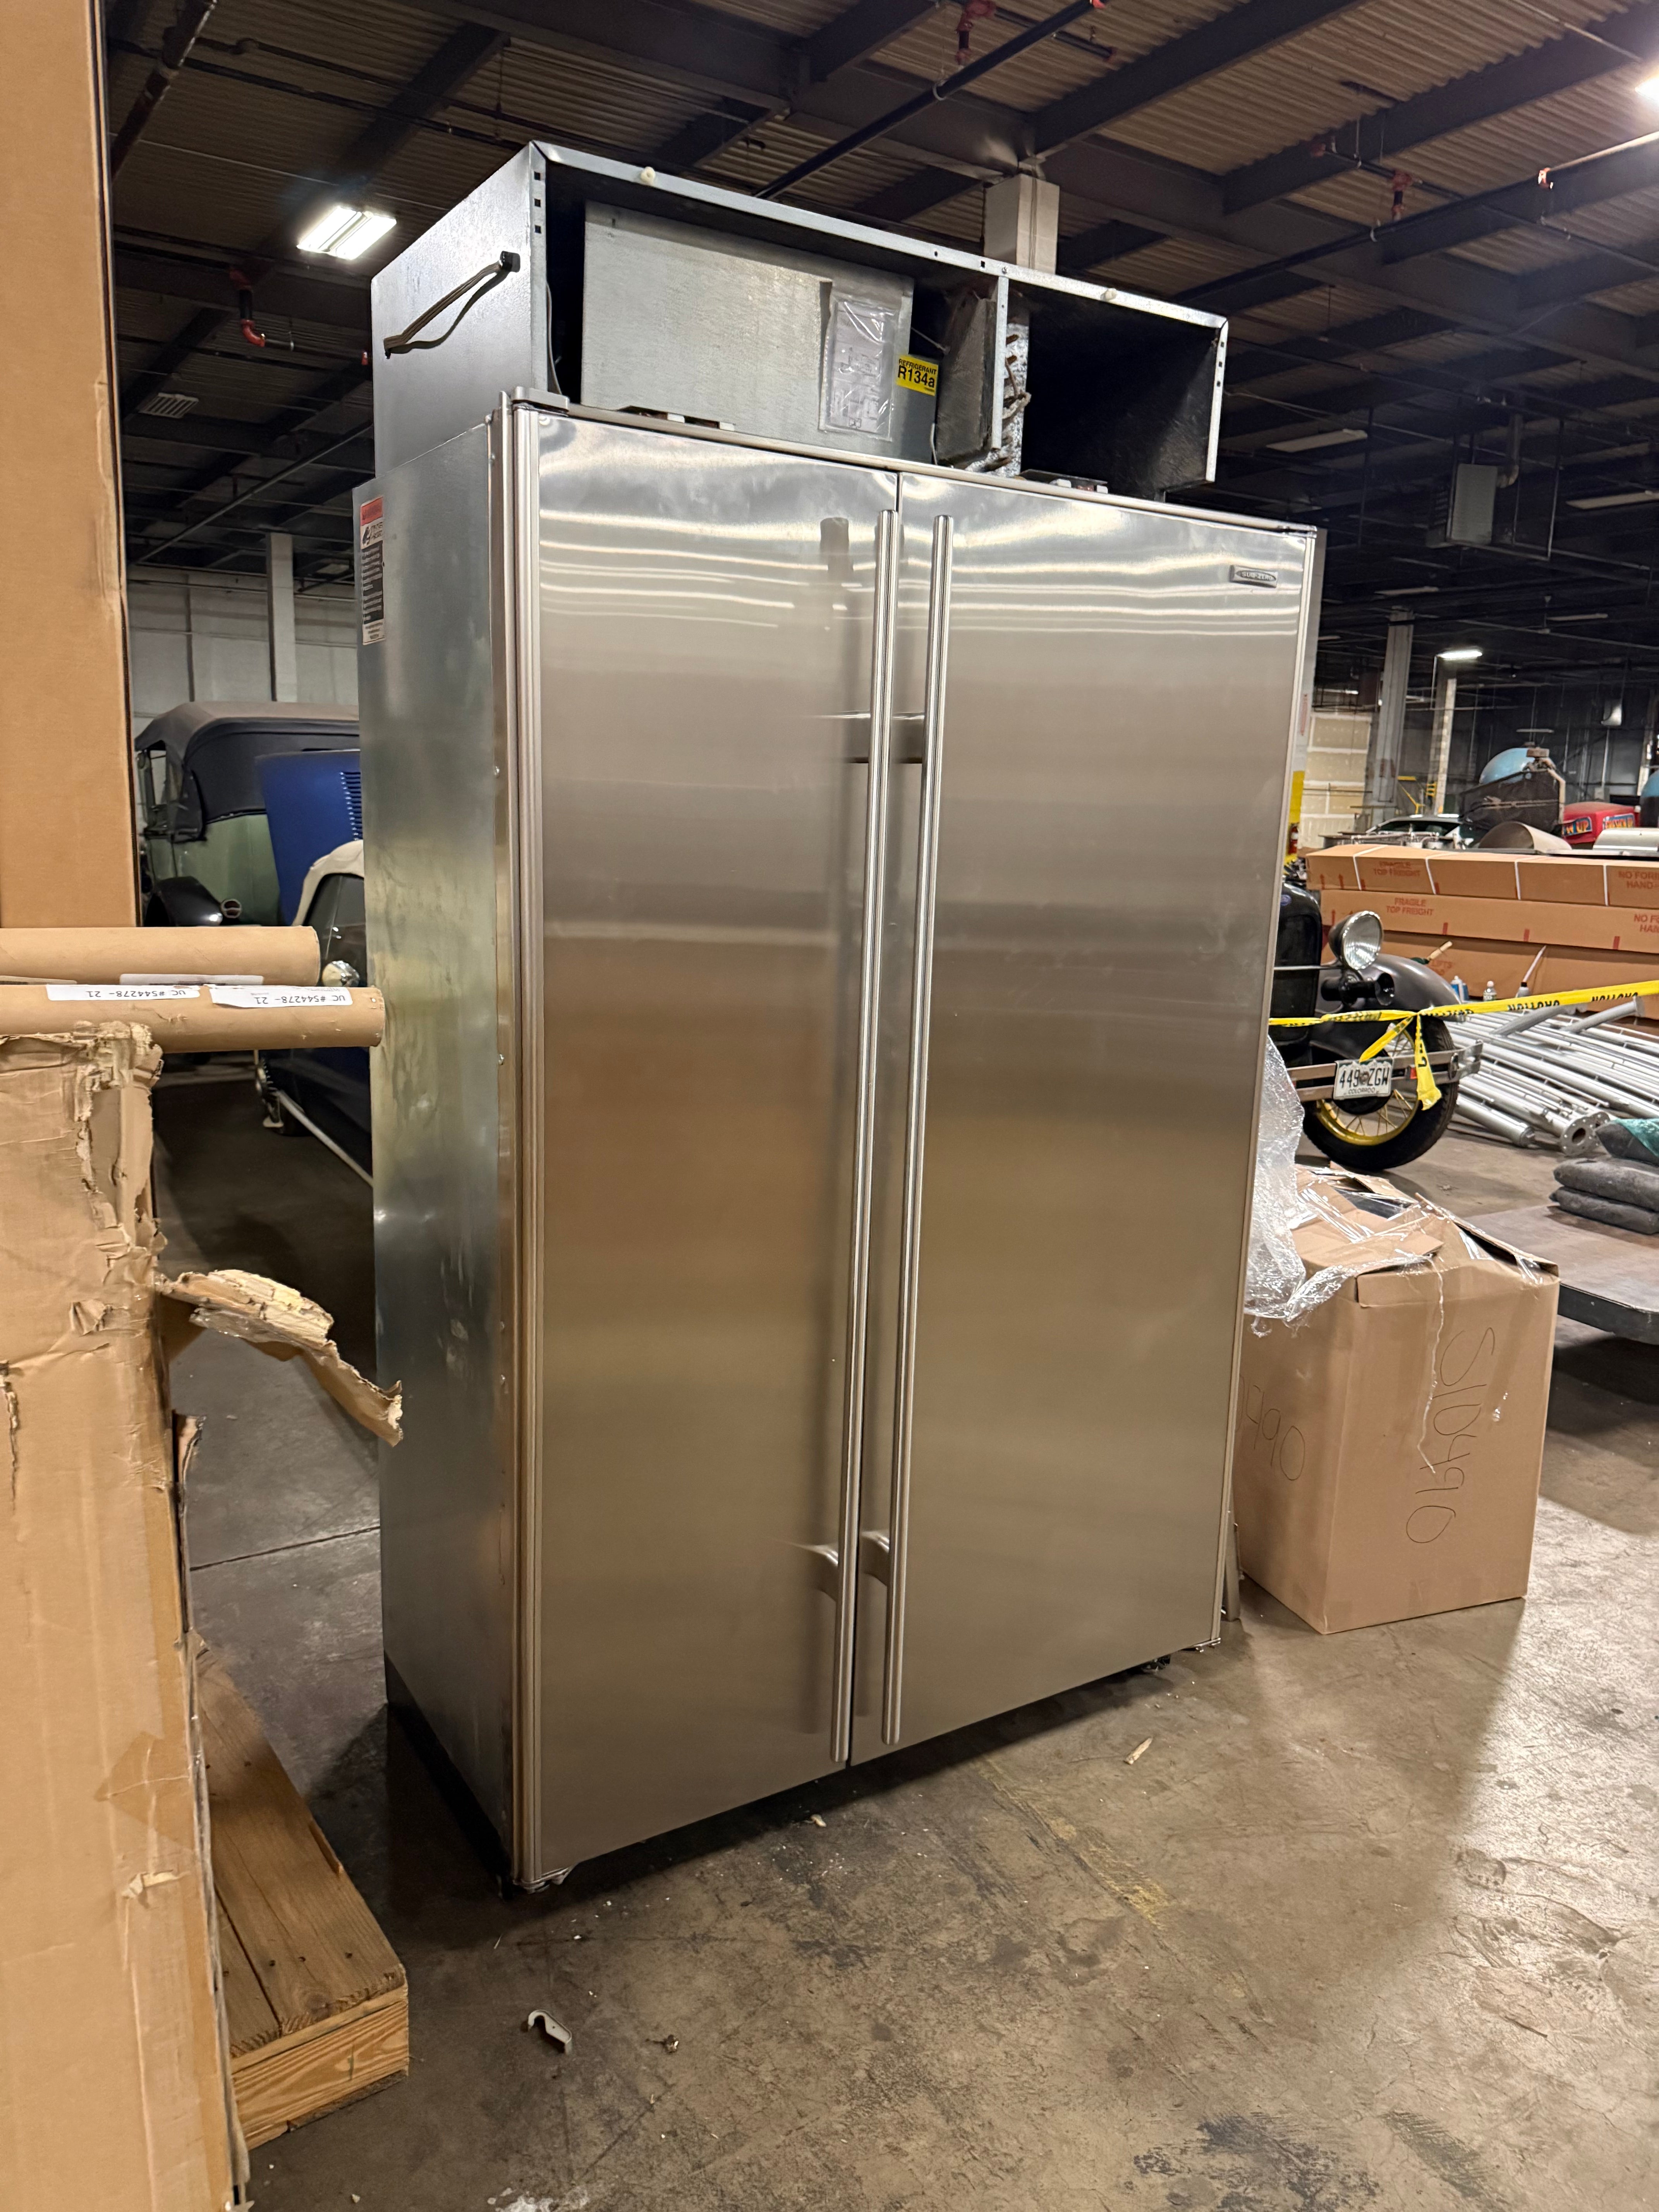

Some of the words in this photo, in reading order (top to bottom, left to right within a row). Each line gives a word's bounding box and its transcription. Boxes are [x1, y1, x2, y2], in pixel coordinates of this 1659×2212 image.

[898, 359, 937, 375] REFRIGERANT
[898, 365, 935, 388] R134a
[1395, 897, 1426, 907] FRAGILE
[1634, 914, 1648, 922] NO
[1340, 1069, 1360, 1088] 449
[1367, 1067, 1389, 1086] ZGW
